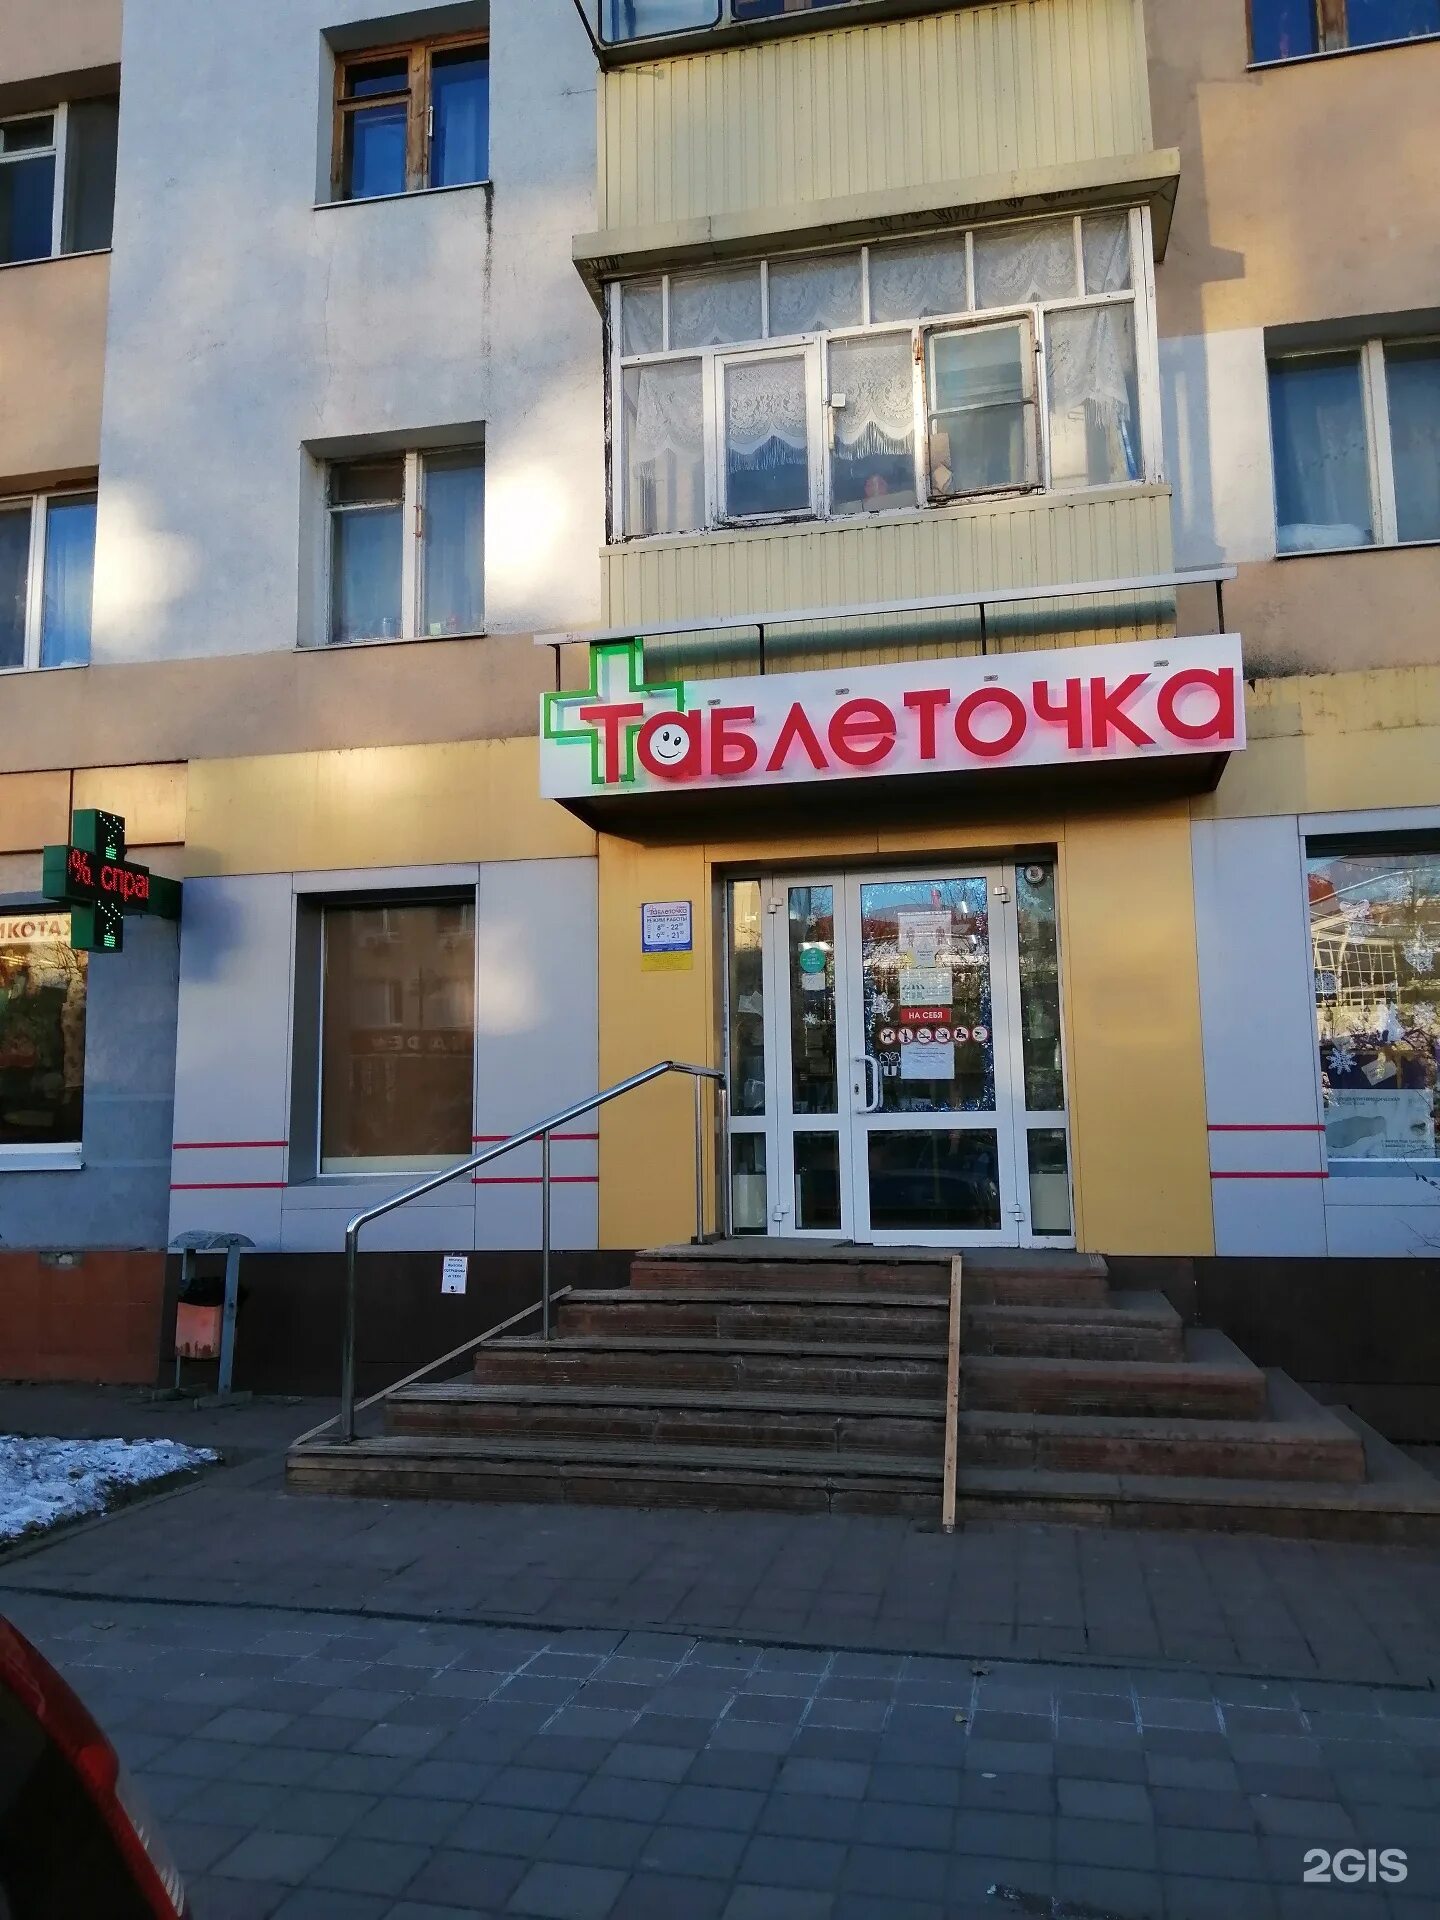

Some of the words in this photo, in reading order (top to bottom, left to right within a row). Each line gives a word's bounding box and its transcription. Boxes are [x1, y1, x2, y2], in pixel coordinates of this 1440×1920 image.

[580, 667, 1235, 783] Таблеточка
[908, 1011, 921, 1019] НА
[922, 1011, 943, 1019] СЕБЯ
